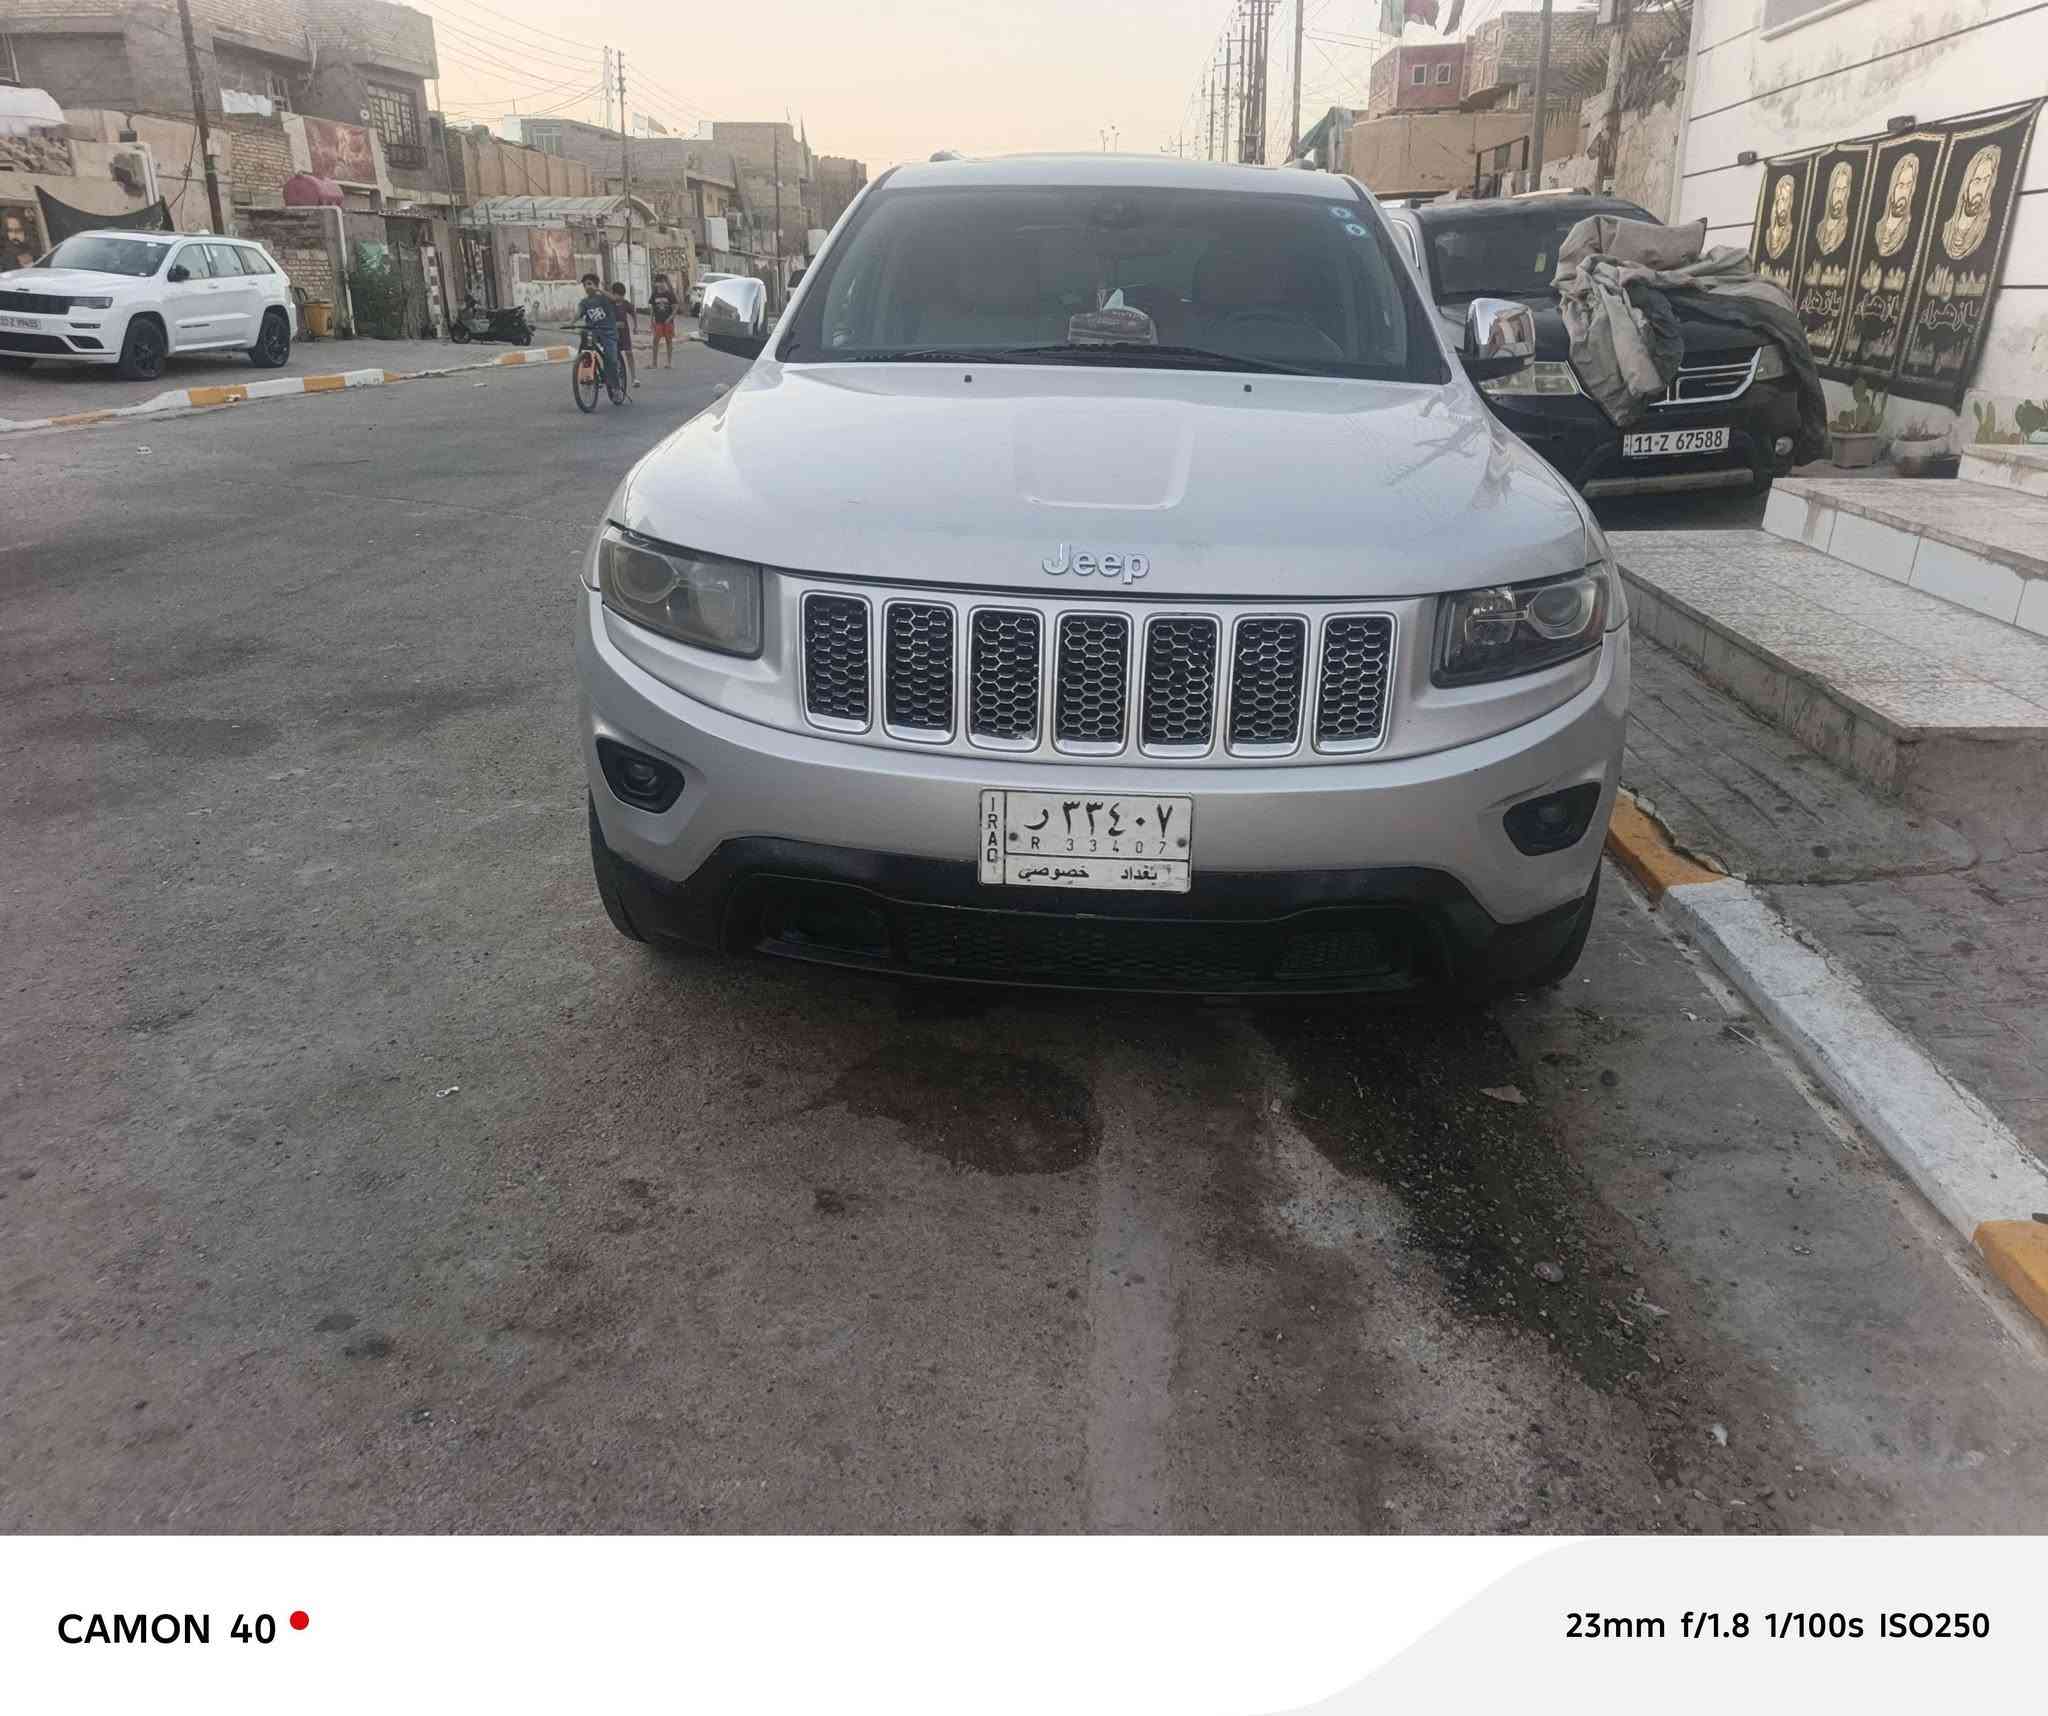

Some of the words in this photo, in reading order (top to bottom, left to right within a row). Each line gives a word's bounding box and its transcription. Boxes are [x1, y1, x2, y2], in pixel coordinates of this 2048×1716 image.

[1675, 430, 1723, 450] 67588
[1042, 543, 1151, 585] Jeep
[987, 797, 998, 863] IRAQ
[1018, 865, 1090, 883] خصوصي
[1121, 864, 1158, 886] بغداد
